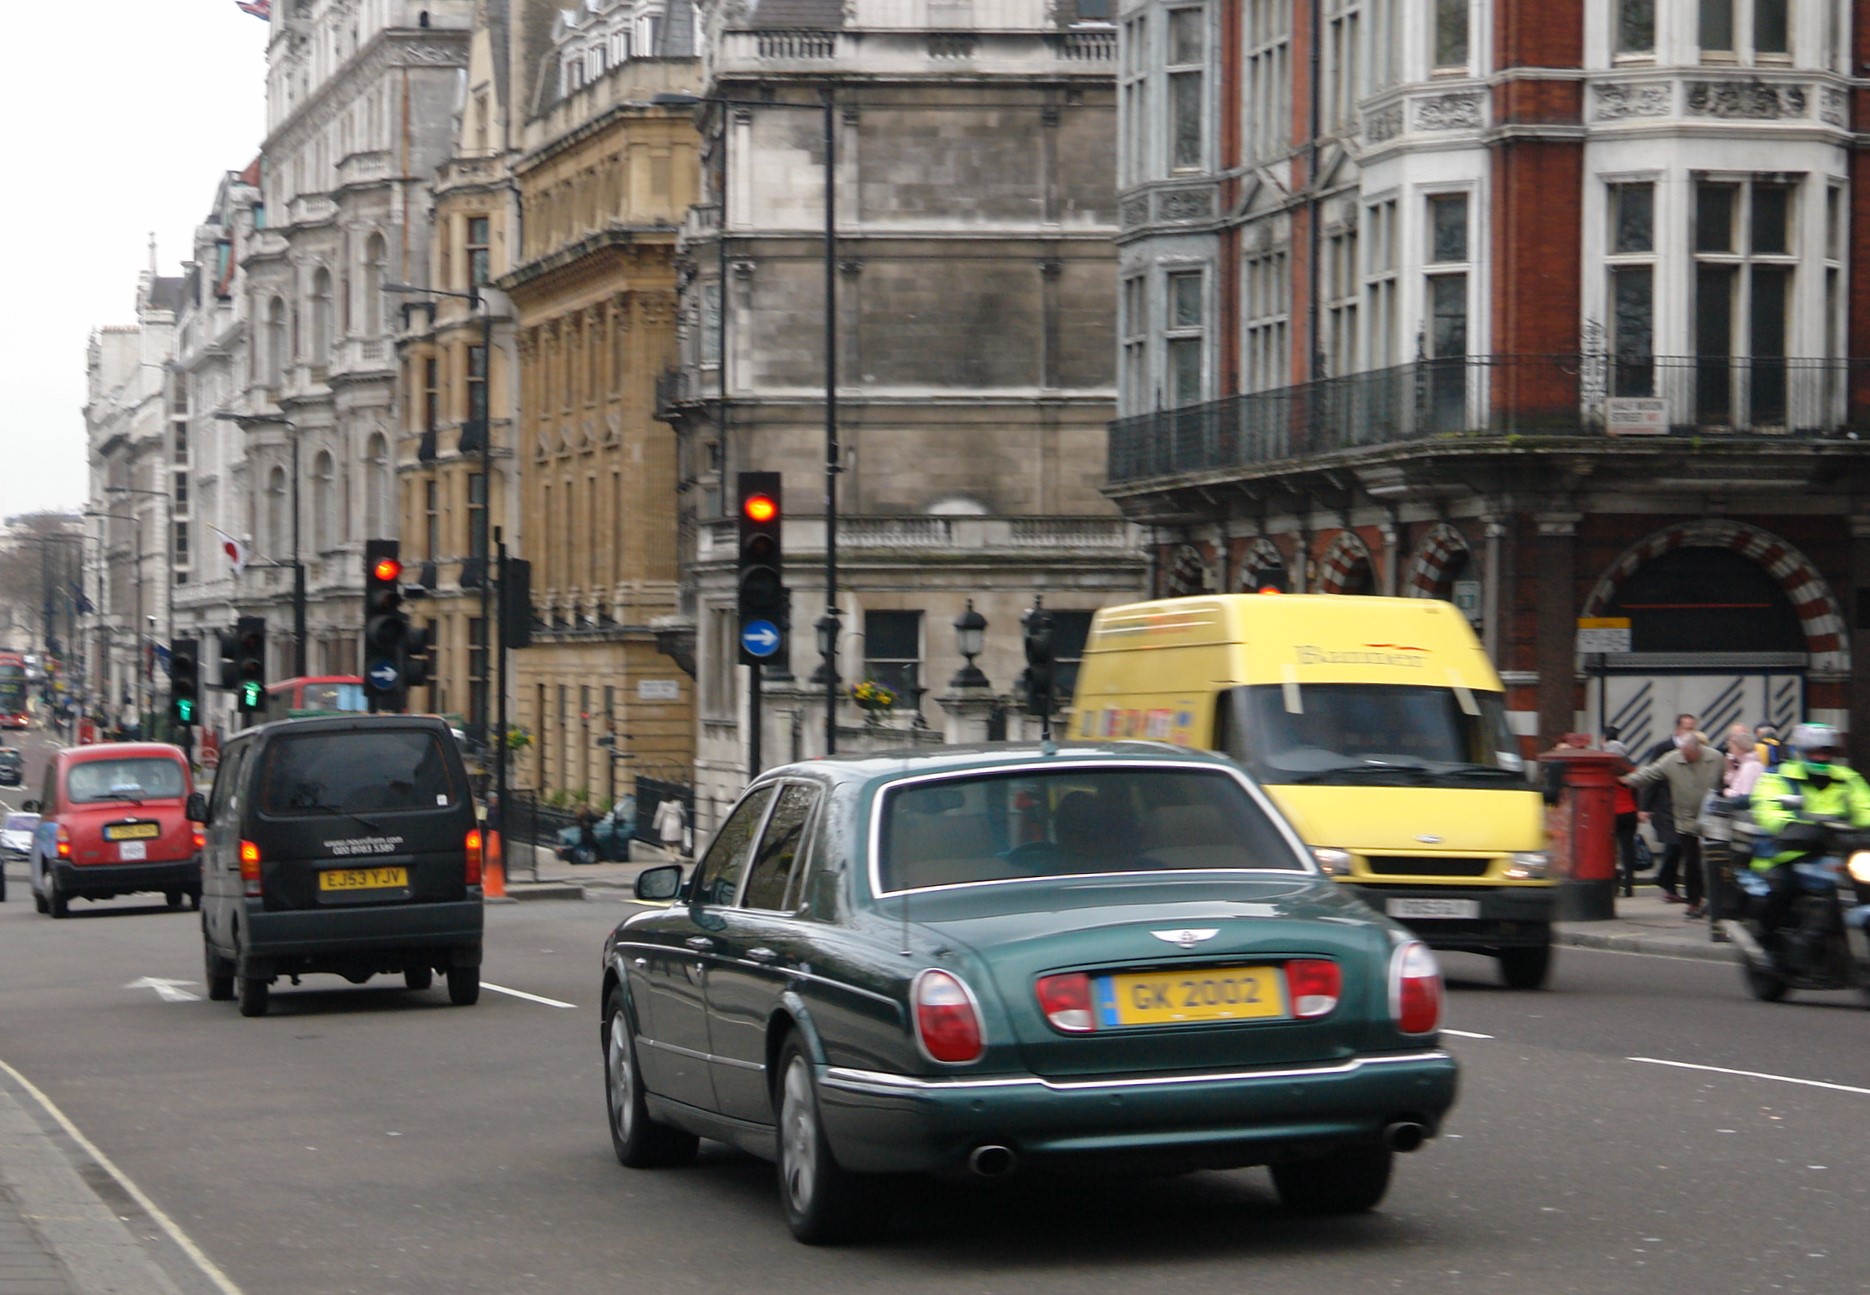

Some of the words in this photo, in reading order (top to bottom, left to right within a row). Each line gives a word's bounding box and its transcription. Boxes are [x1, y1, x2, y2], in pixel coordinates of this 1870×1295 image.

[1611, 413, 1642, 422] STREET
[327, 870, 367, 887] EJ53
[370, 869, 401, 885] YJV
[1132, 983, 1173, 1010] GK
[1181, 977, 1262, 1008] 2002
